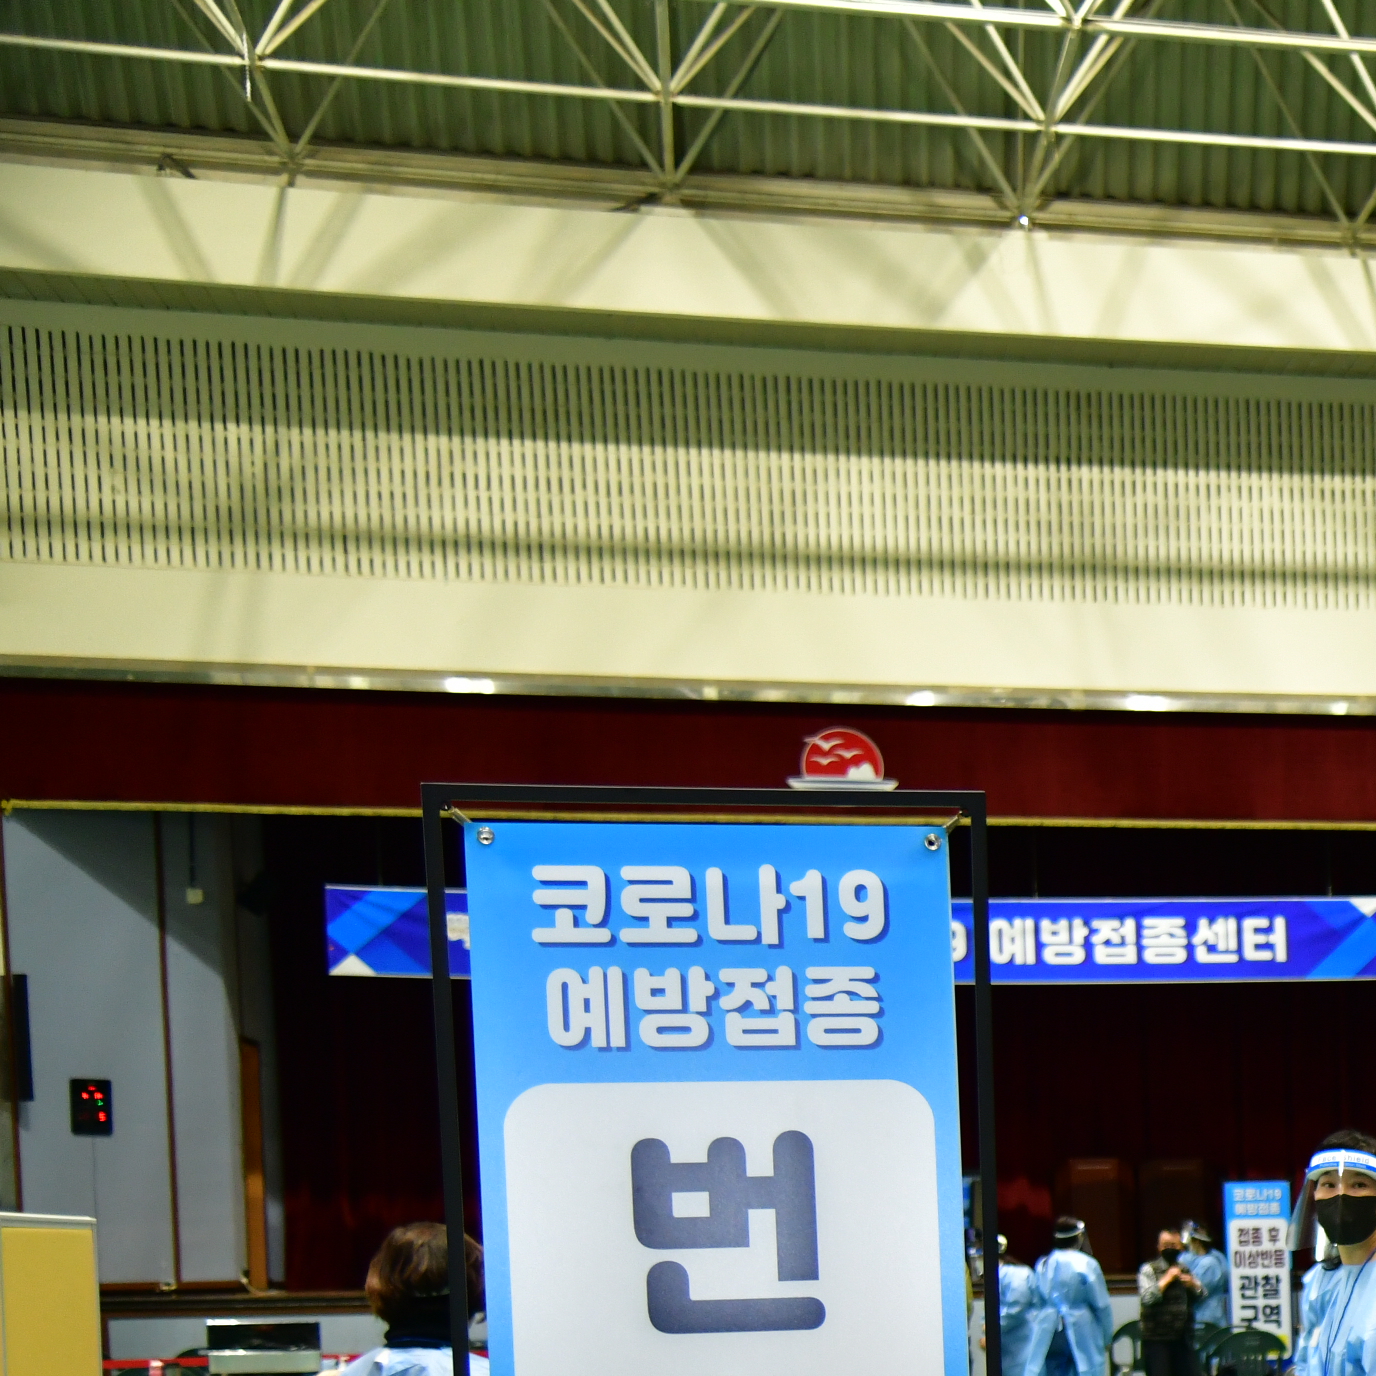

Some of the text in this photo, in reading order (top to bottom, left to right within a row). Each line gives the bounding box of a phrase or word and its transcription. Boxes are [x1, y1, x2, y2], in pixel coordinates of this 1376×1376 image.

[531, 863, 887, 945] 코로나19
[988, 916, 1287, 965] 예방접종센터
[546, 965, 882, 1049] 예방접종
[1238, 1227, 1280, 1247] 접종 후
[1234, 1250, 1285, 1269] 이상반응
[1239, 1274, 1282, 1300] 관찰
